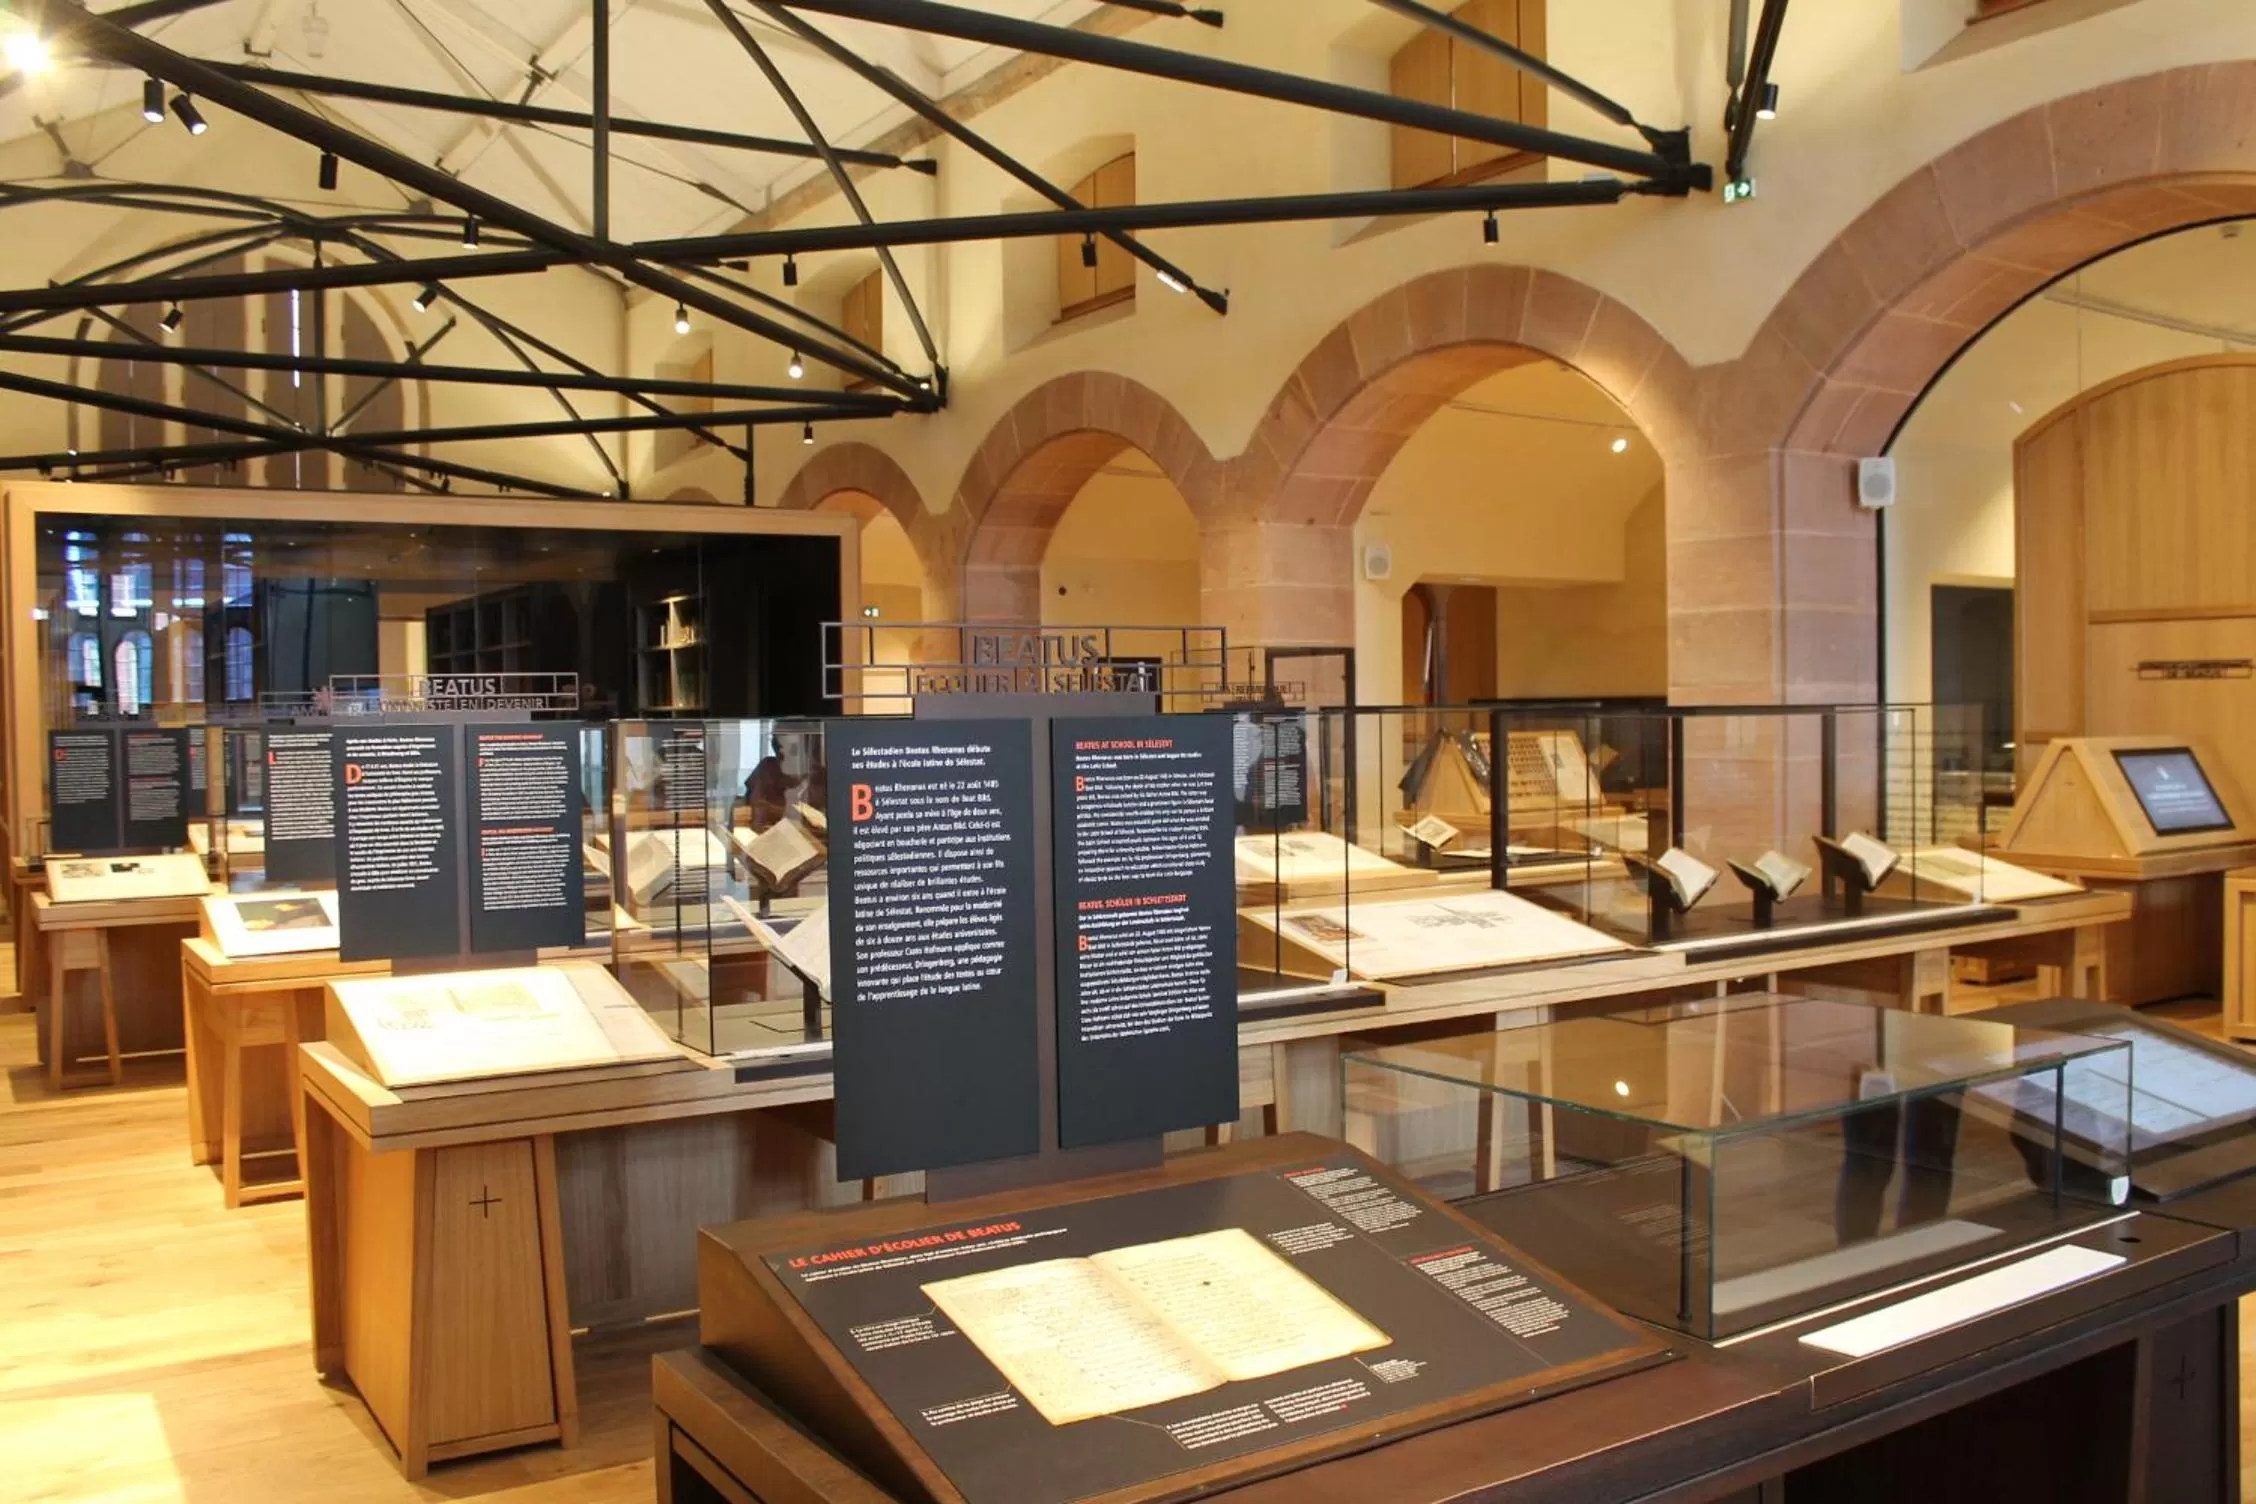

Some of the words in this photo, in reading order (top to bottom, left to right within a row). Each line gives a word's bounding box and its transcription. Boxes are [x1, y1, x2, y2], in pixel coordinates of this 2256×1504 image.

[974, 635, 1101, 666] BEATUS
[419, 677, 497, 696] BEATUS
[460, 699, 477, 710] EN
[488, 697, 545, 710] DEVENIR
[811, 1249, 867, 1264] CAHIER
[944, 1231, 967, 1242] DE
[967, 1221, 1021, 1238] BEATUS
